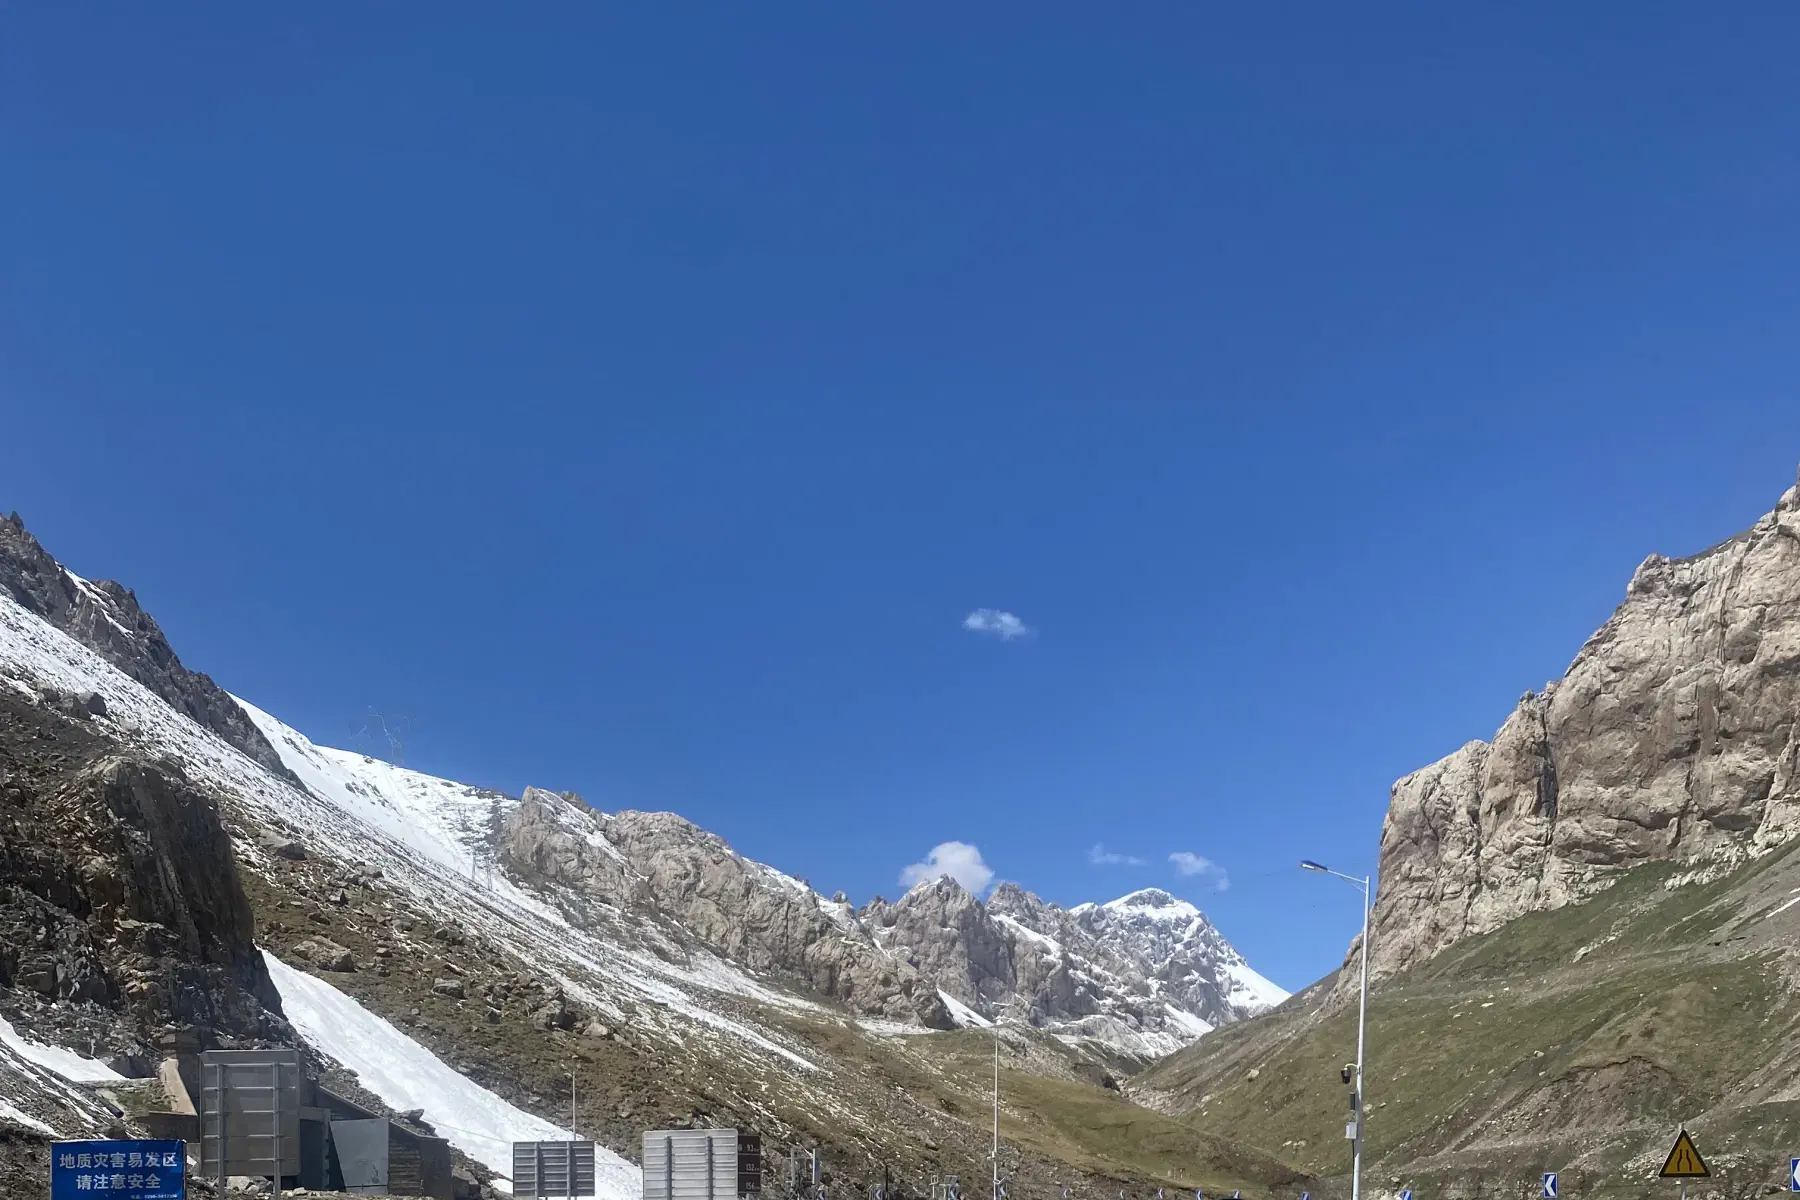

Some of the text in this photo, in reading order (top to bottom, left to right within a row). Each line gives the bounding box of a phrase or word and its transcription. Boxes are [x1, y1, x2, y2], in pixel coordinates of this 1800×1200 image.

[59, 1152, 178, 1169] 地质灾害易发区
[75, 1173, 162, 1190] 请注意安全
